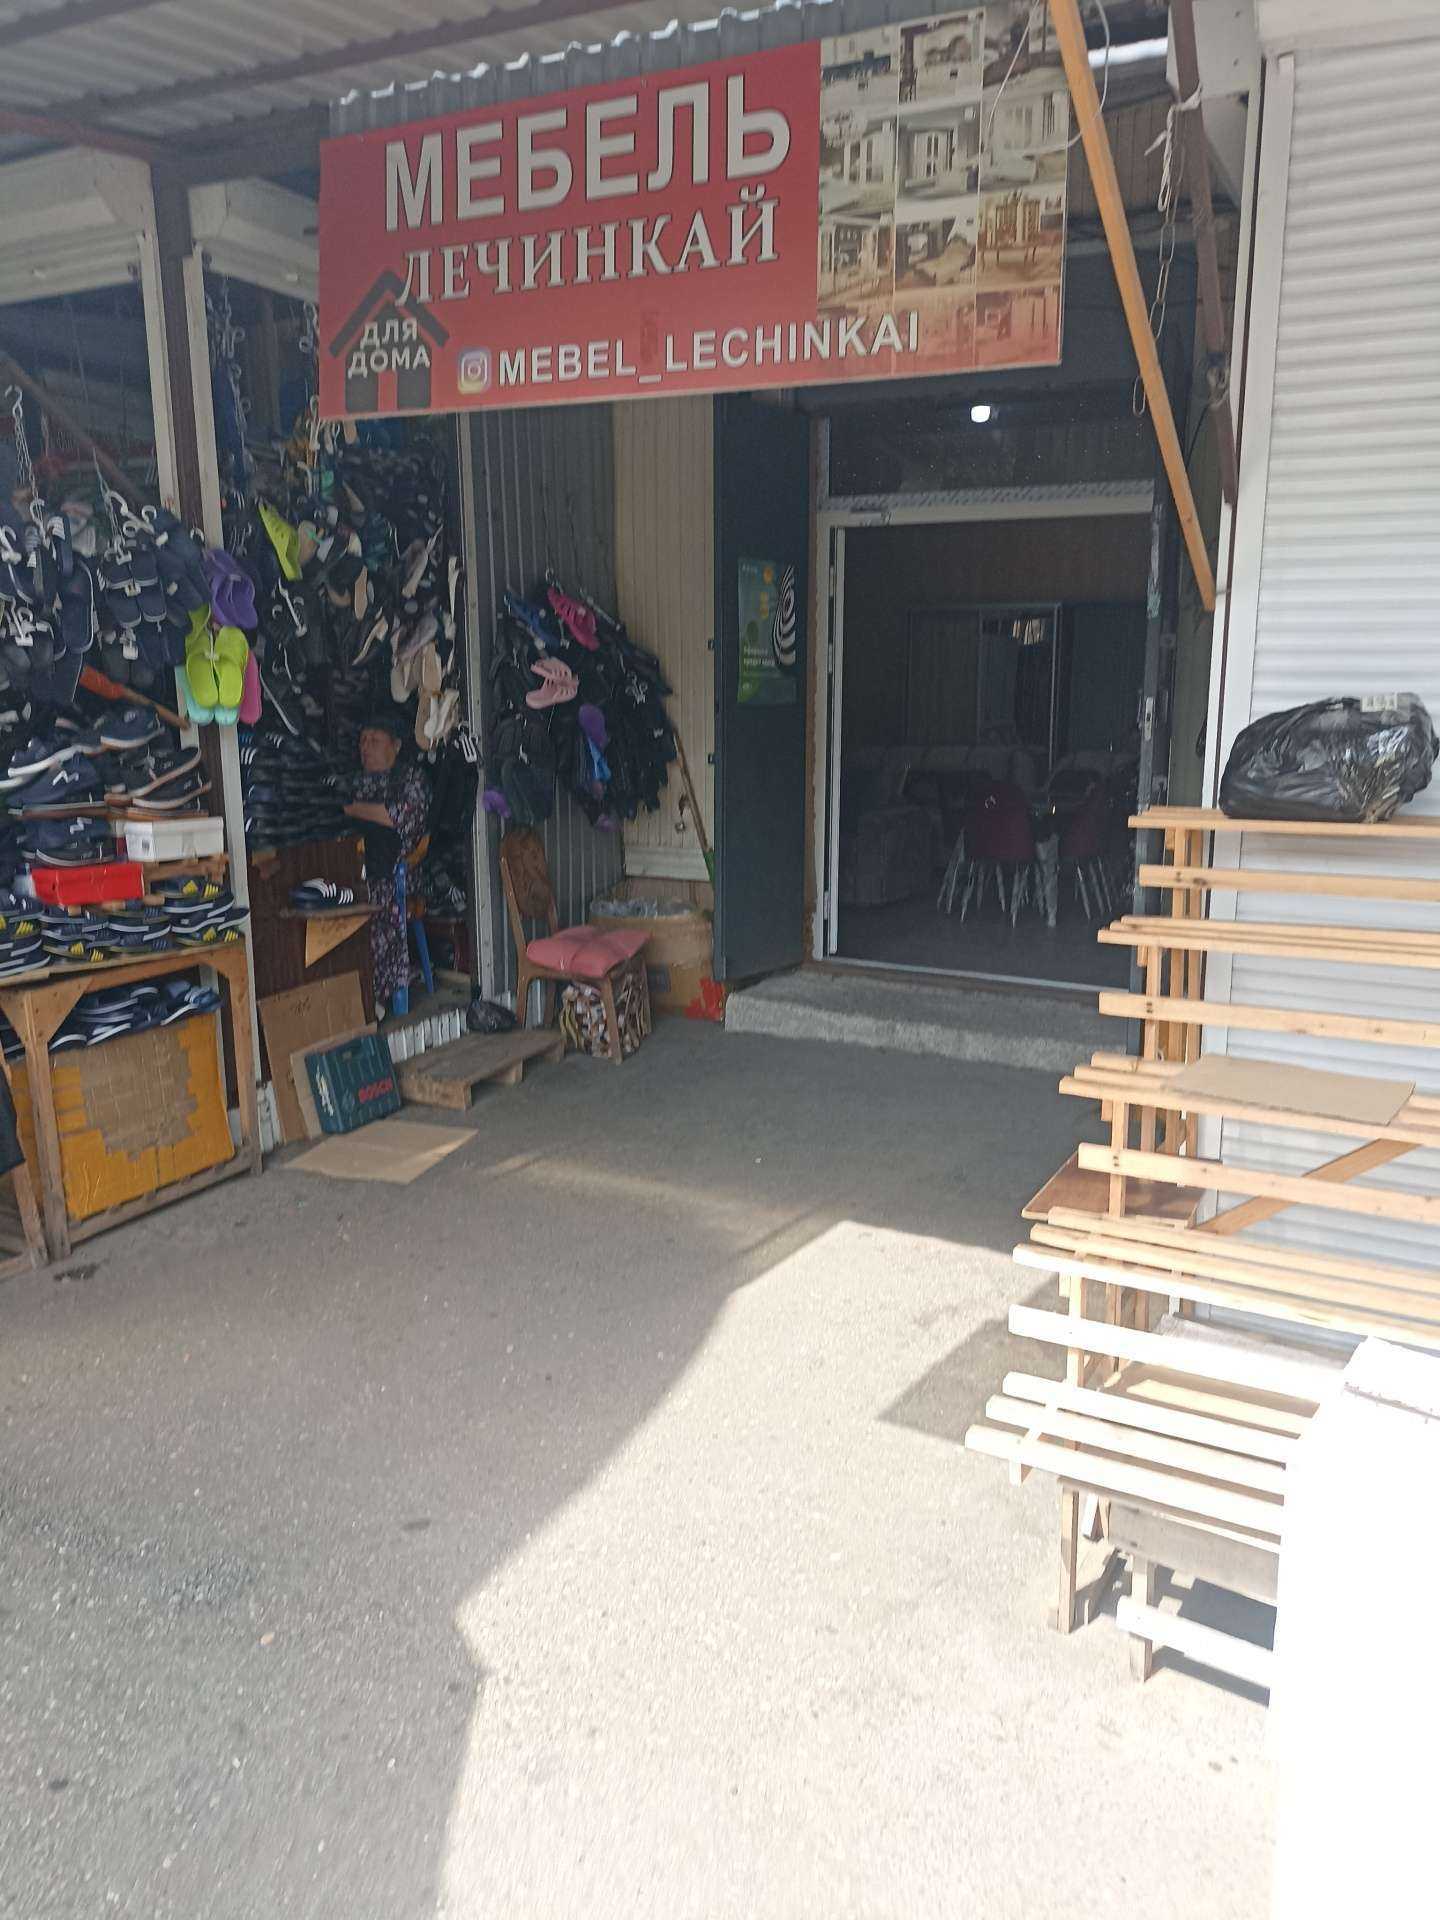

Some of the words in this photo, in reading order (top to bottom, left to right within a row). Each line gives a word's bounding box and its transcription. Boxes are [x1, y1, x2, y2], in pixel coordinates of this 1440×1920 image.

[385, 74, 791, 232] МЕБЕЛЬ
[395, 184, 779, 306] ЛЕЧИНКАЙ
[347, 344, 431, 379] ДОМА
[359, 317, 418, 350] ДЛЯ
[498, 311, 919, 385] MEBEL_LECHINKAI
